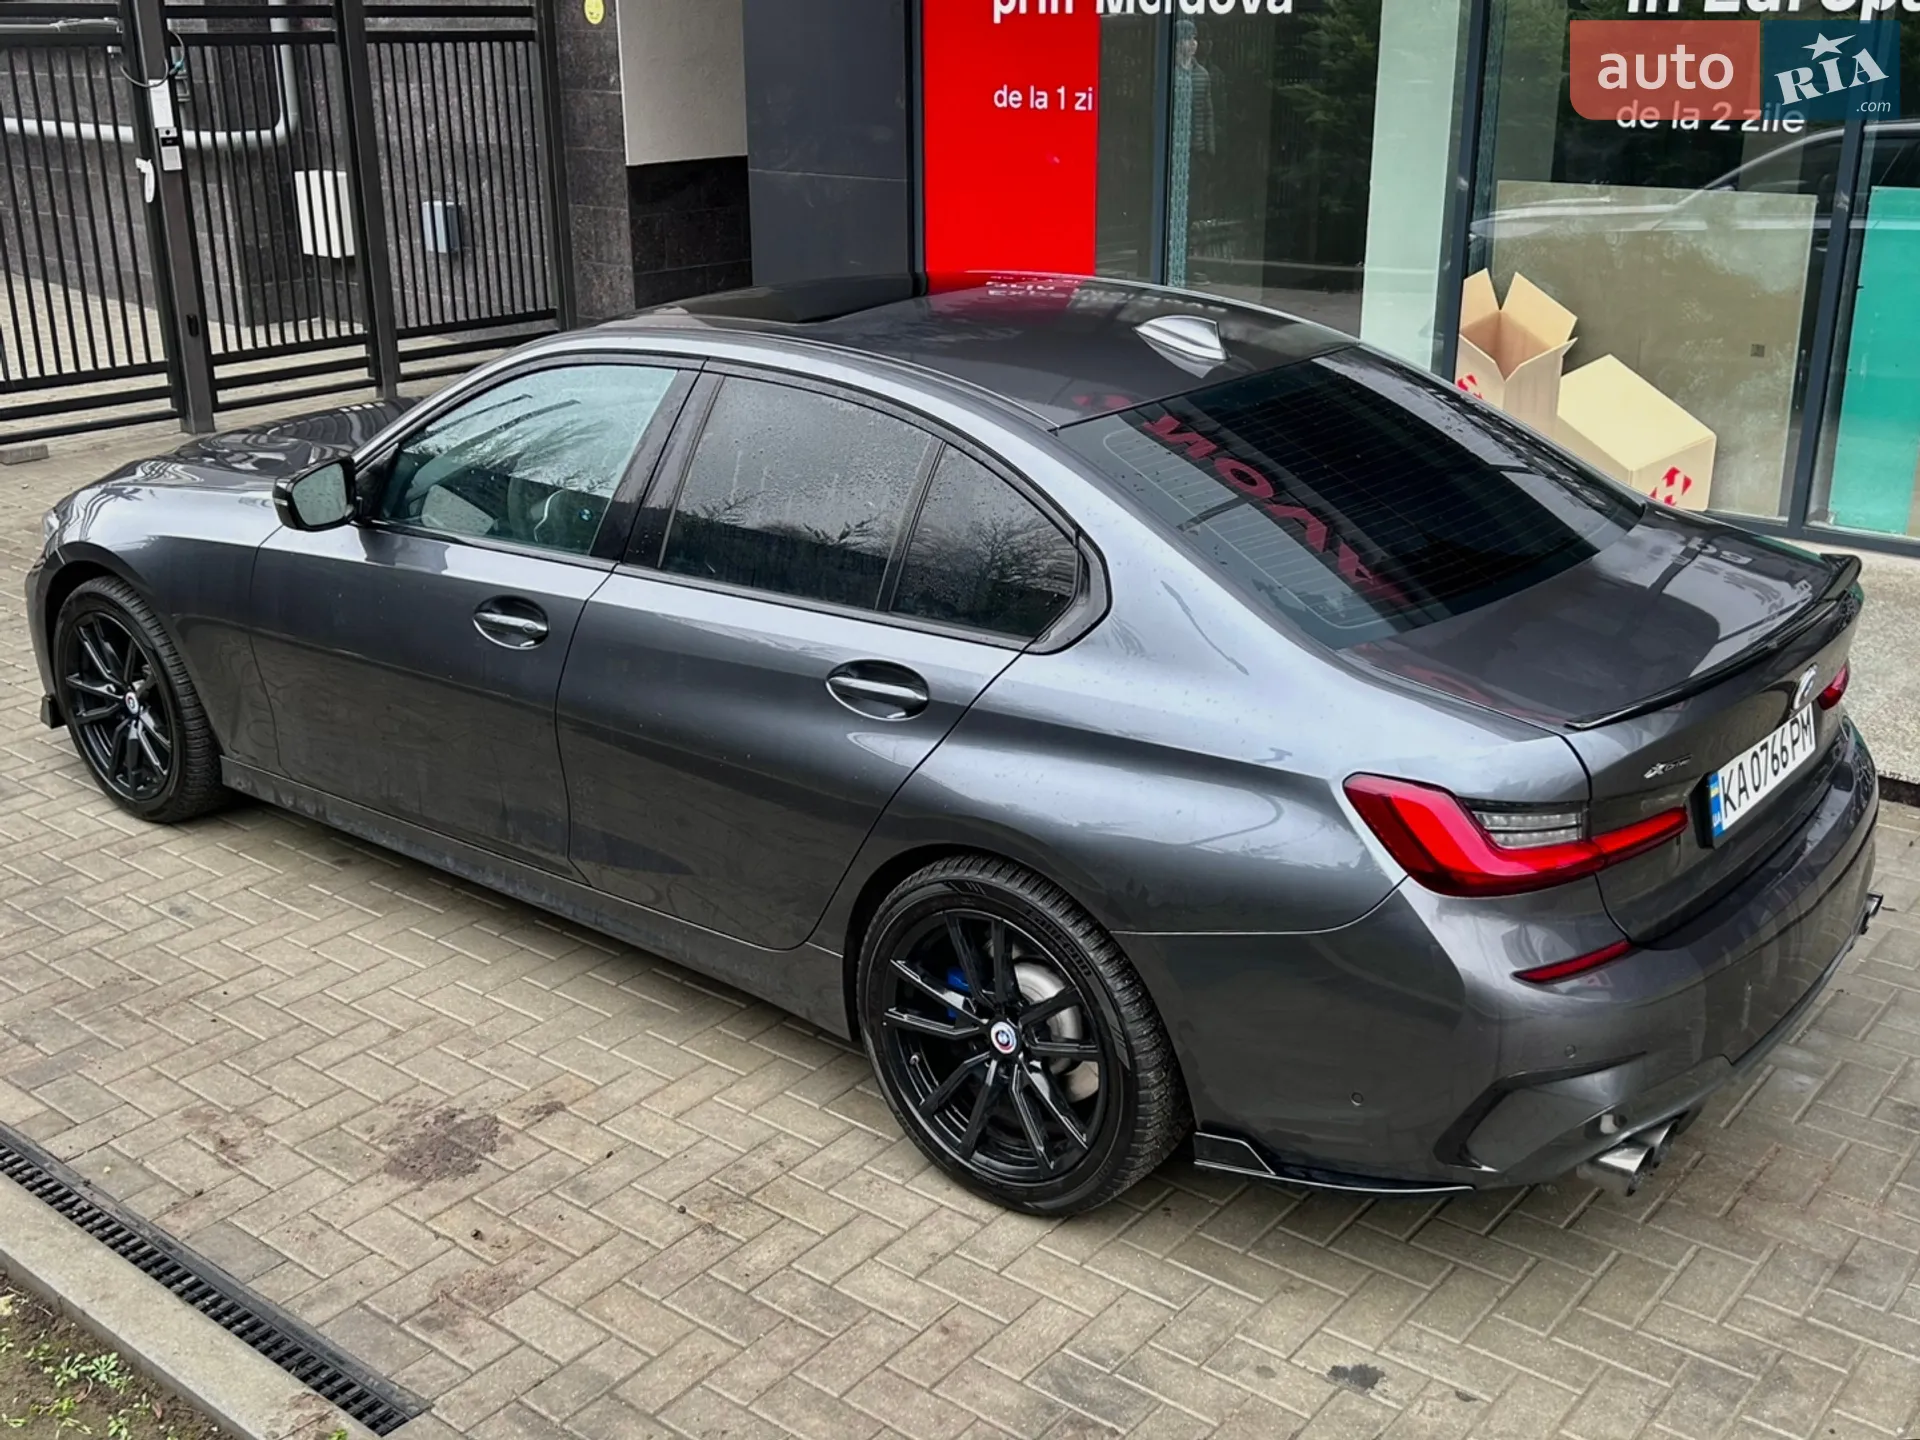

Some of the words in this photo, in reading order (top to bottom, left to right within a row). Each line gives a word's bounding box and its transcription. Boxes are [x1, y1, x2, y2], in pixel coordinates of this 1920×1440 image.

[993, 84, 1023, 109] de
[1029, 85, 1048, 110] la
[1056, 85, 1065, 110] 1
[1074, 86, 1093, 111] zi
[1615, 99, 1661, 129] de
[1671, 100, 1700, 131] la
[1709, 101, 1733, 132] 2
[1741, 101, 1805, 133] zile
